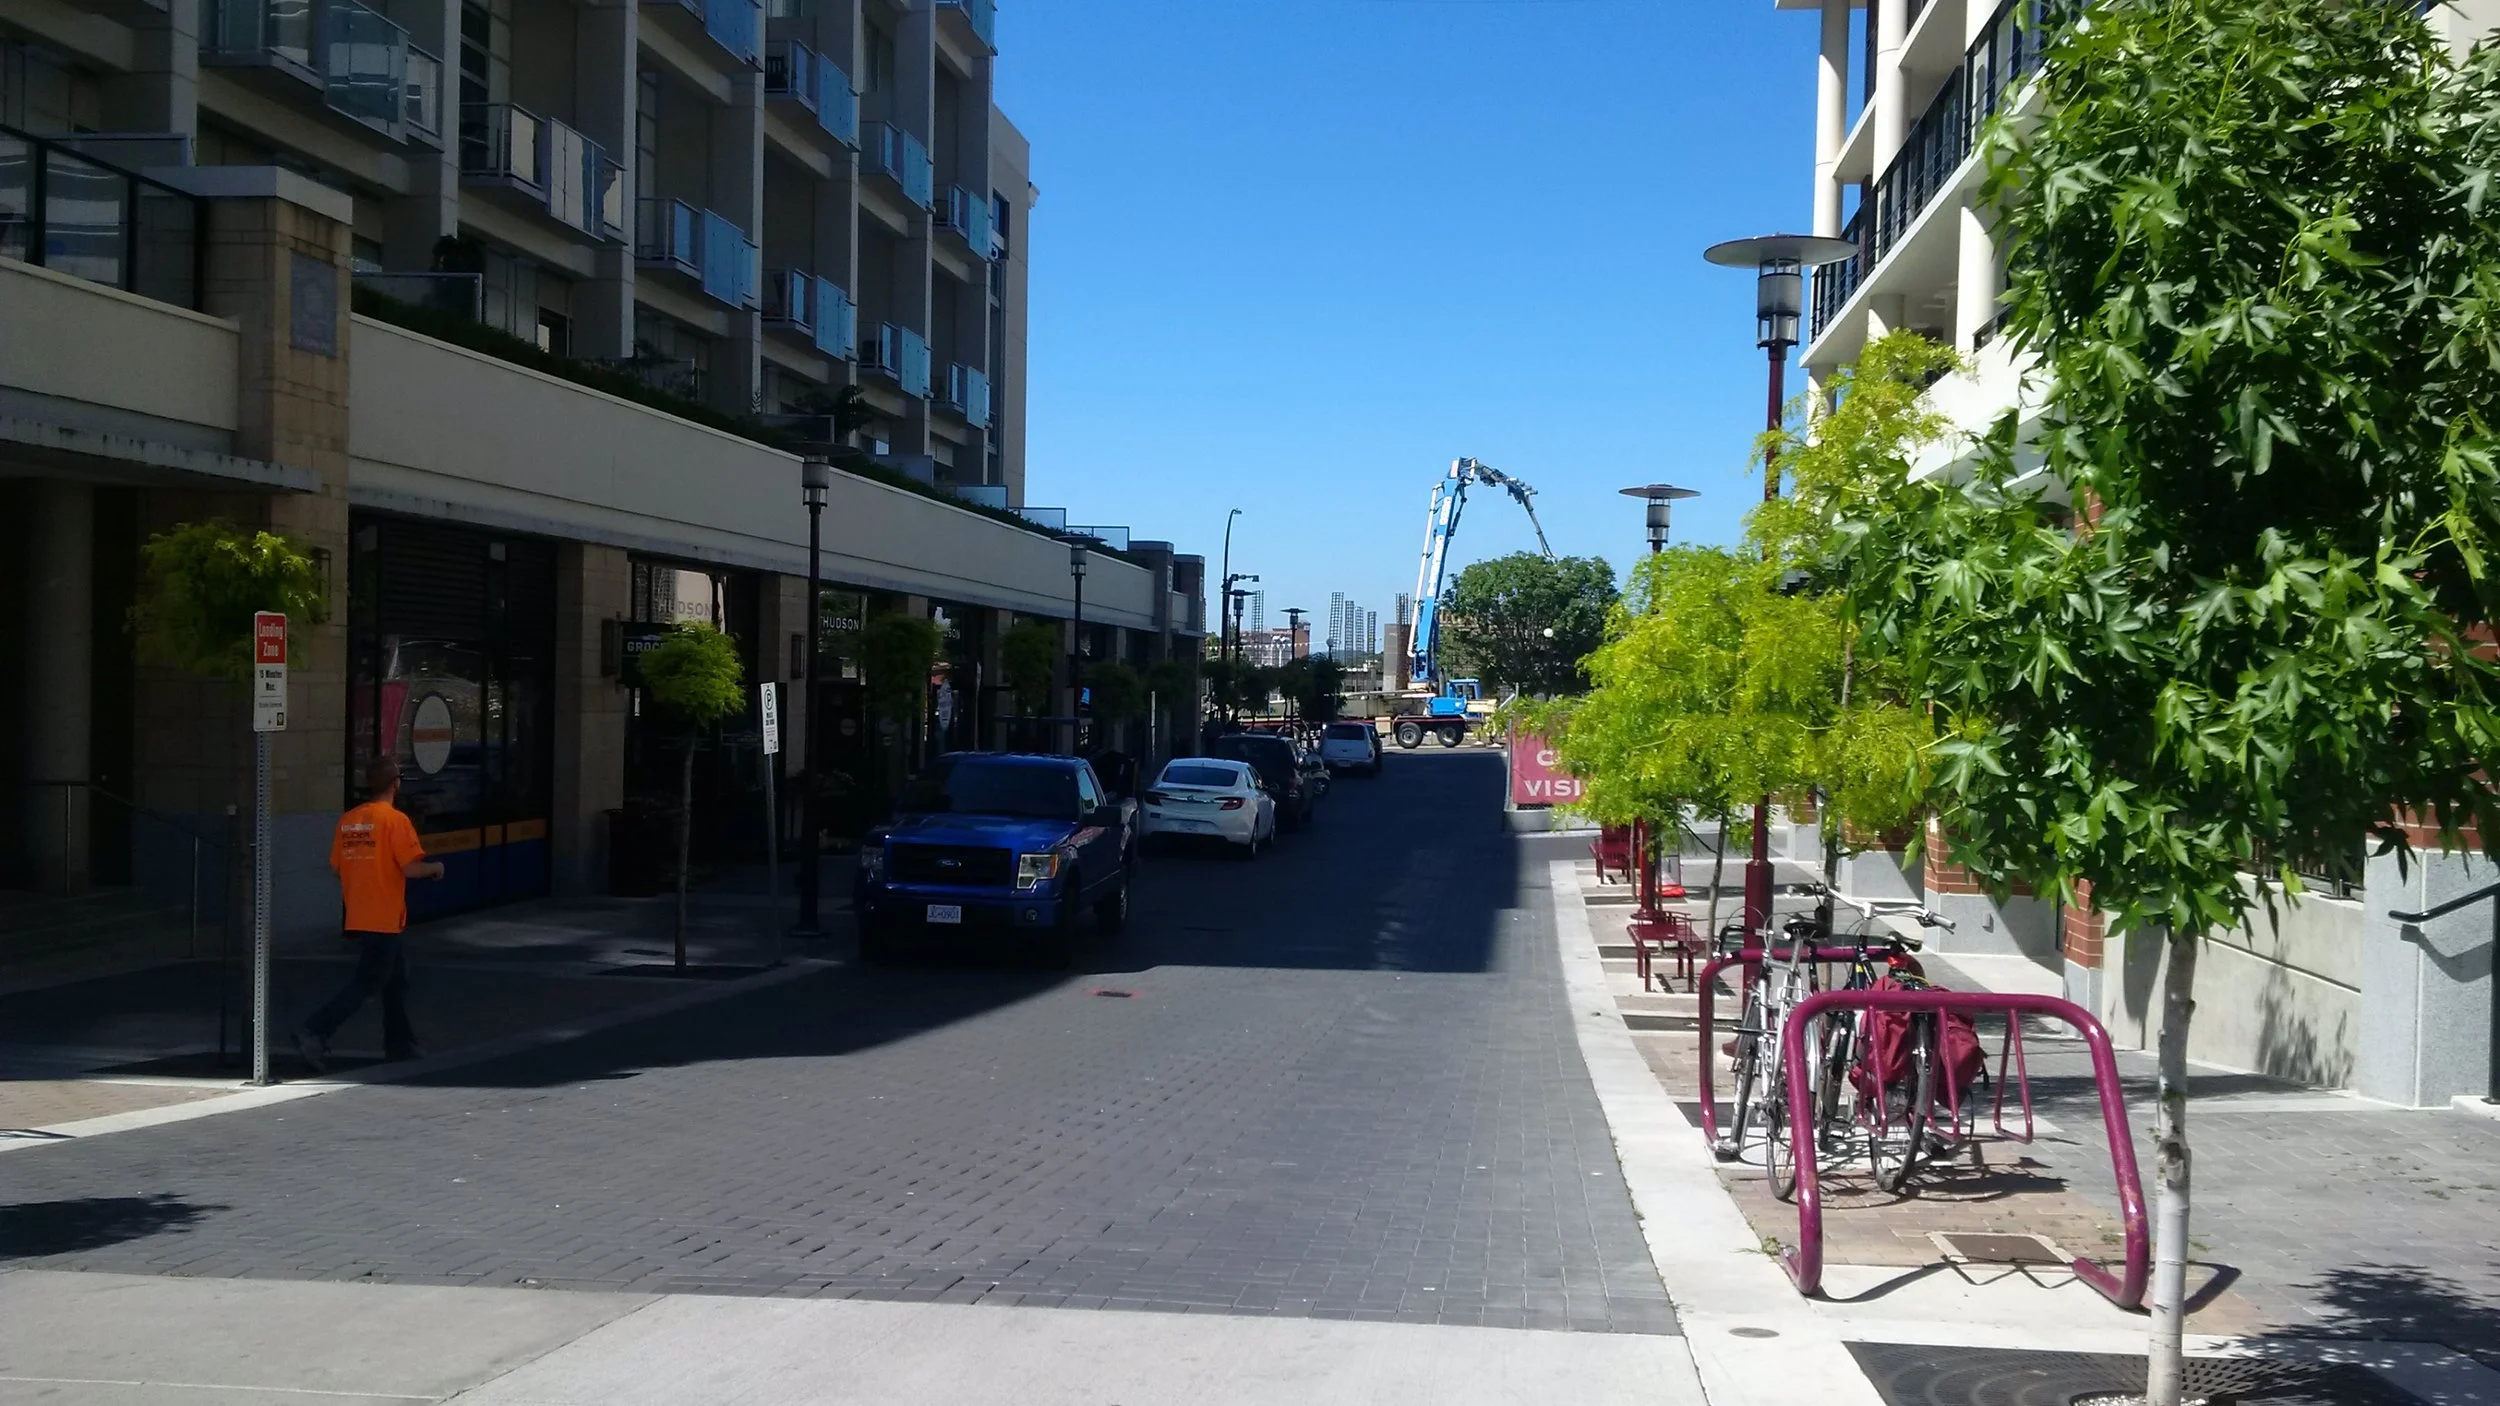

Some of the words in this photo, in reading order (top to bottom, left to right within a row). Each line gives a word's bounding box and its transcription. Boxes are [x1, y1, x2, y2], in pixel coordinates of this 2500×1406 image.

[659, 600, 712, 616] HUDSON
[258, 622, 283, 640] Loading
[823, 616, 859, 630] HUDSON
[263, 642, 279, 657] Zone
[1524, 780, 1581, 797] VISI
